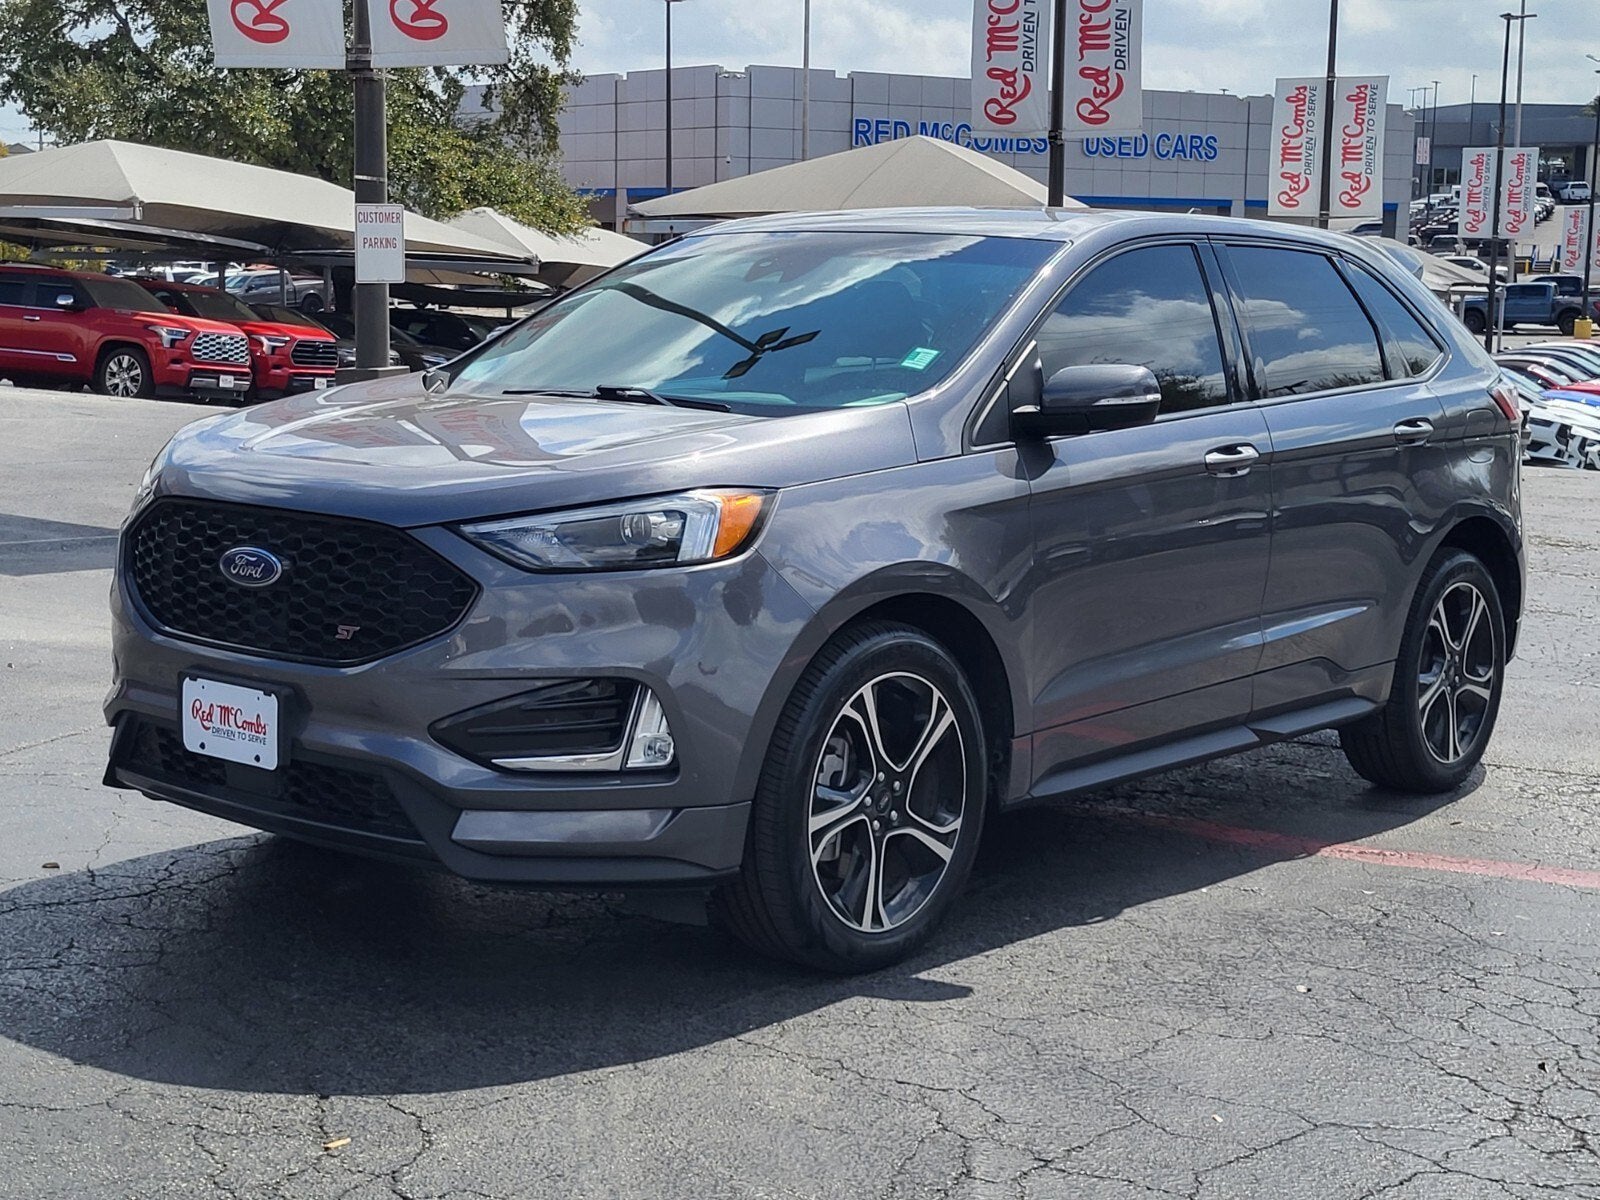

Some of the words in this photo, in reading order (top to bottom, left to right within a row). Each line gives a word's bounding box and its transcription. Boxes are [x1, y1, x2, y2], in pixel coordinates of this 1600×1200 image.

[1022, 11, 1036, 72] DRIVEN
[1114, 8, 1127, 71] DRIVEN
[984, 66, 1032, 125] Red
[1076, 66, 1124, 125] Red
[1307, 85, 1317, 117] SERVE
[1368, 83, 1378, 116] SERVE
[1280, 85, 1308, 168] McCombs
[1305, 119, 1315, 134] TO
[1341, 84, 1369, 168] McCombs
[1366, 118, 1376, 133] TO
[1084, 133, 1149, 157] USED
[1155, 132, 1218, 160] CARS
[1303, 137, 1314, 175] DRIVEN
[1364, 136, 1374, 175] DRIVEN
[1277, 171, 1310, 208] Red
[1339, 171, 1371, 208] Red
[1467, 153, 1485, 207] McCombs
[1484, 175, 1490, 185] TO
[1508, 153, 1526, 207] McCombs
[1524, 174, 1531, 184] TO
[358, 211, 401, 224] CUSTOMER
[1464, 208, 1486, 233] Red
[1505, 209, 1527, 233] Red
[362, 237, 397, 249] PARKING
[230, 554, 265, 579] Ford
[335, 624, 360, 640] ST
[191, 698, 214, 731] Red
[216, 704, 267, 736] McCombs
[211, 726, 236, 739] DRIVEN
[237, 732, 247, 741] TO
[248, 734, 267, 746] SERVE
